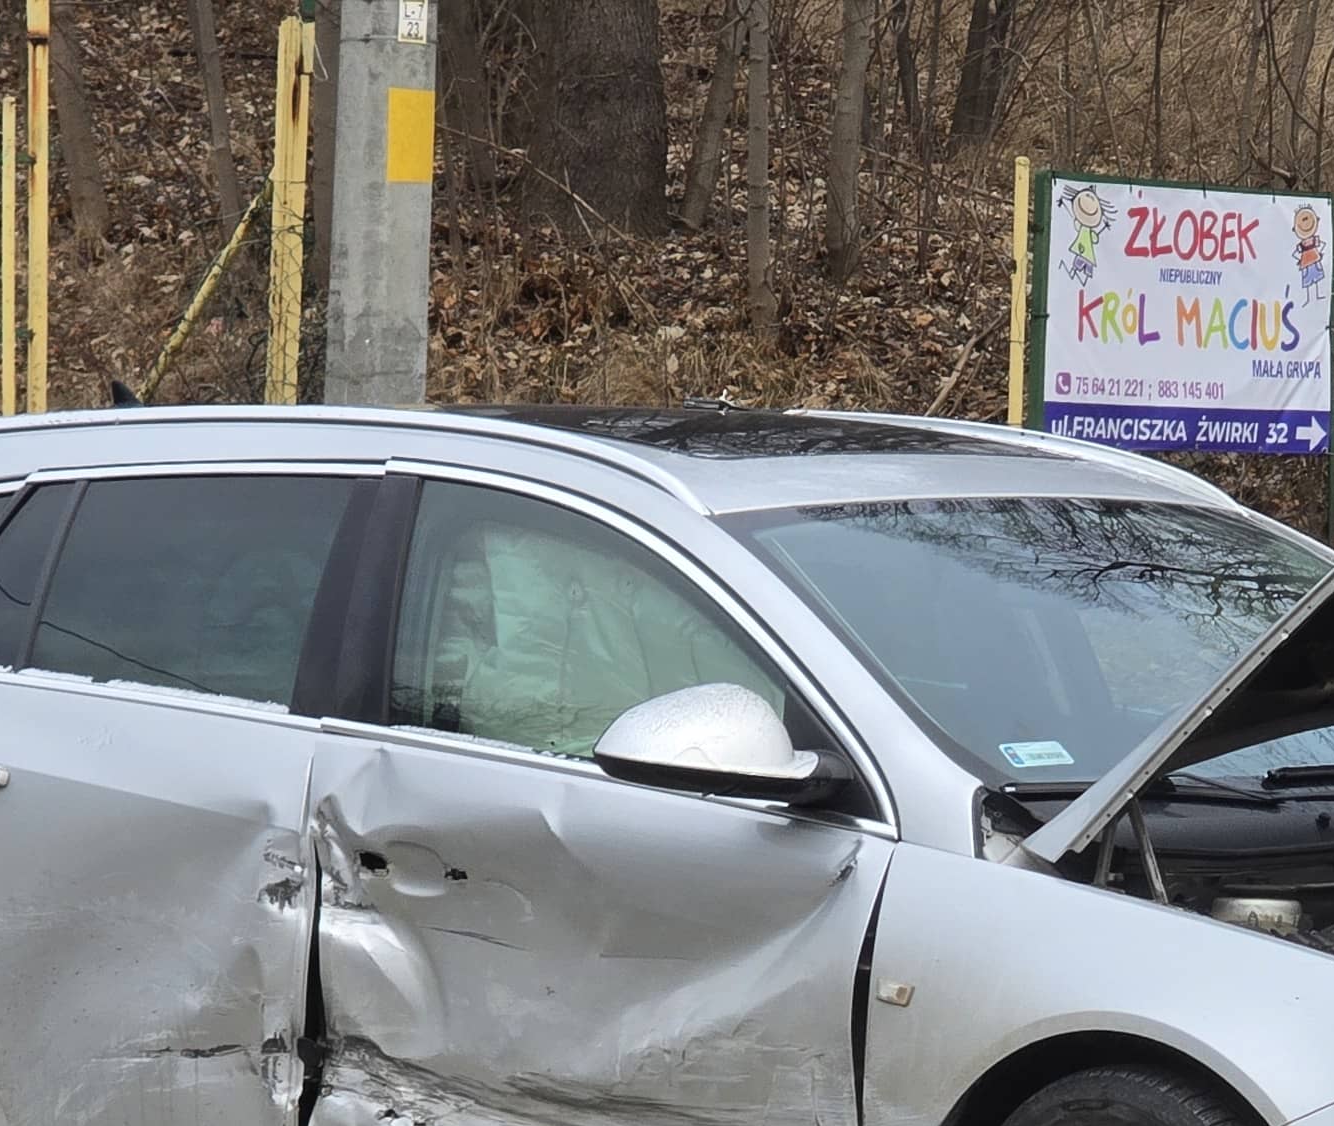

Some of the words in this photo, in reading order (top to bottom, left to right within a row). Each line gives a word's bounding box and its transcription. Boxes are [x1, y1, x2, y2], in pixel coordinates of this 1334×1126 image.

[1123, 190, 1260, 264] ŻŁOBEK
[1159, 268, 1222, 285] NIEPUBLICZNY
[1077, 287, 1161, 346] KRÓL
[1176, 284, 1300, 352] MACIUŚ
[1252, 359, 1283, 378] MAŁA
[1286, 360, 1321, 379] GRUPA
[1075, 376, 1089, 395] 75
[1091, 377, 1105, 396] 64
[1108, 378, 1121, 396] 21
[1124, 379, 1144, 397] 221
[1158, 380, 1179, 398] 883
[1182, 381, 1202, 400] 145
[1205, 382, 1224, 400] 401
[1051, 415, 1188, 442] ul.FRANCISZKA
[1195, 415, 1259, 443] ŻWIRKI
[1265, 422, 1288, 444] 32
